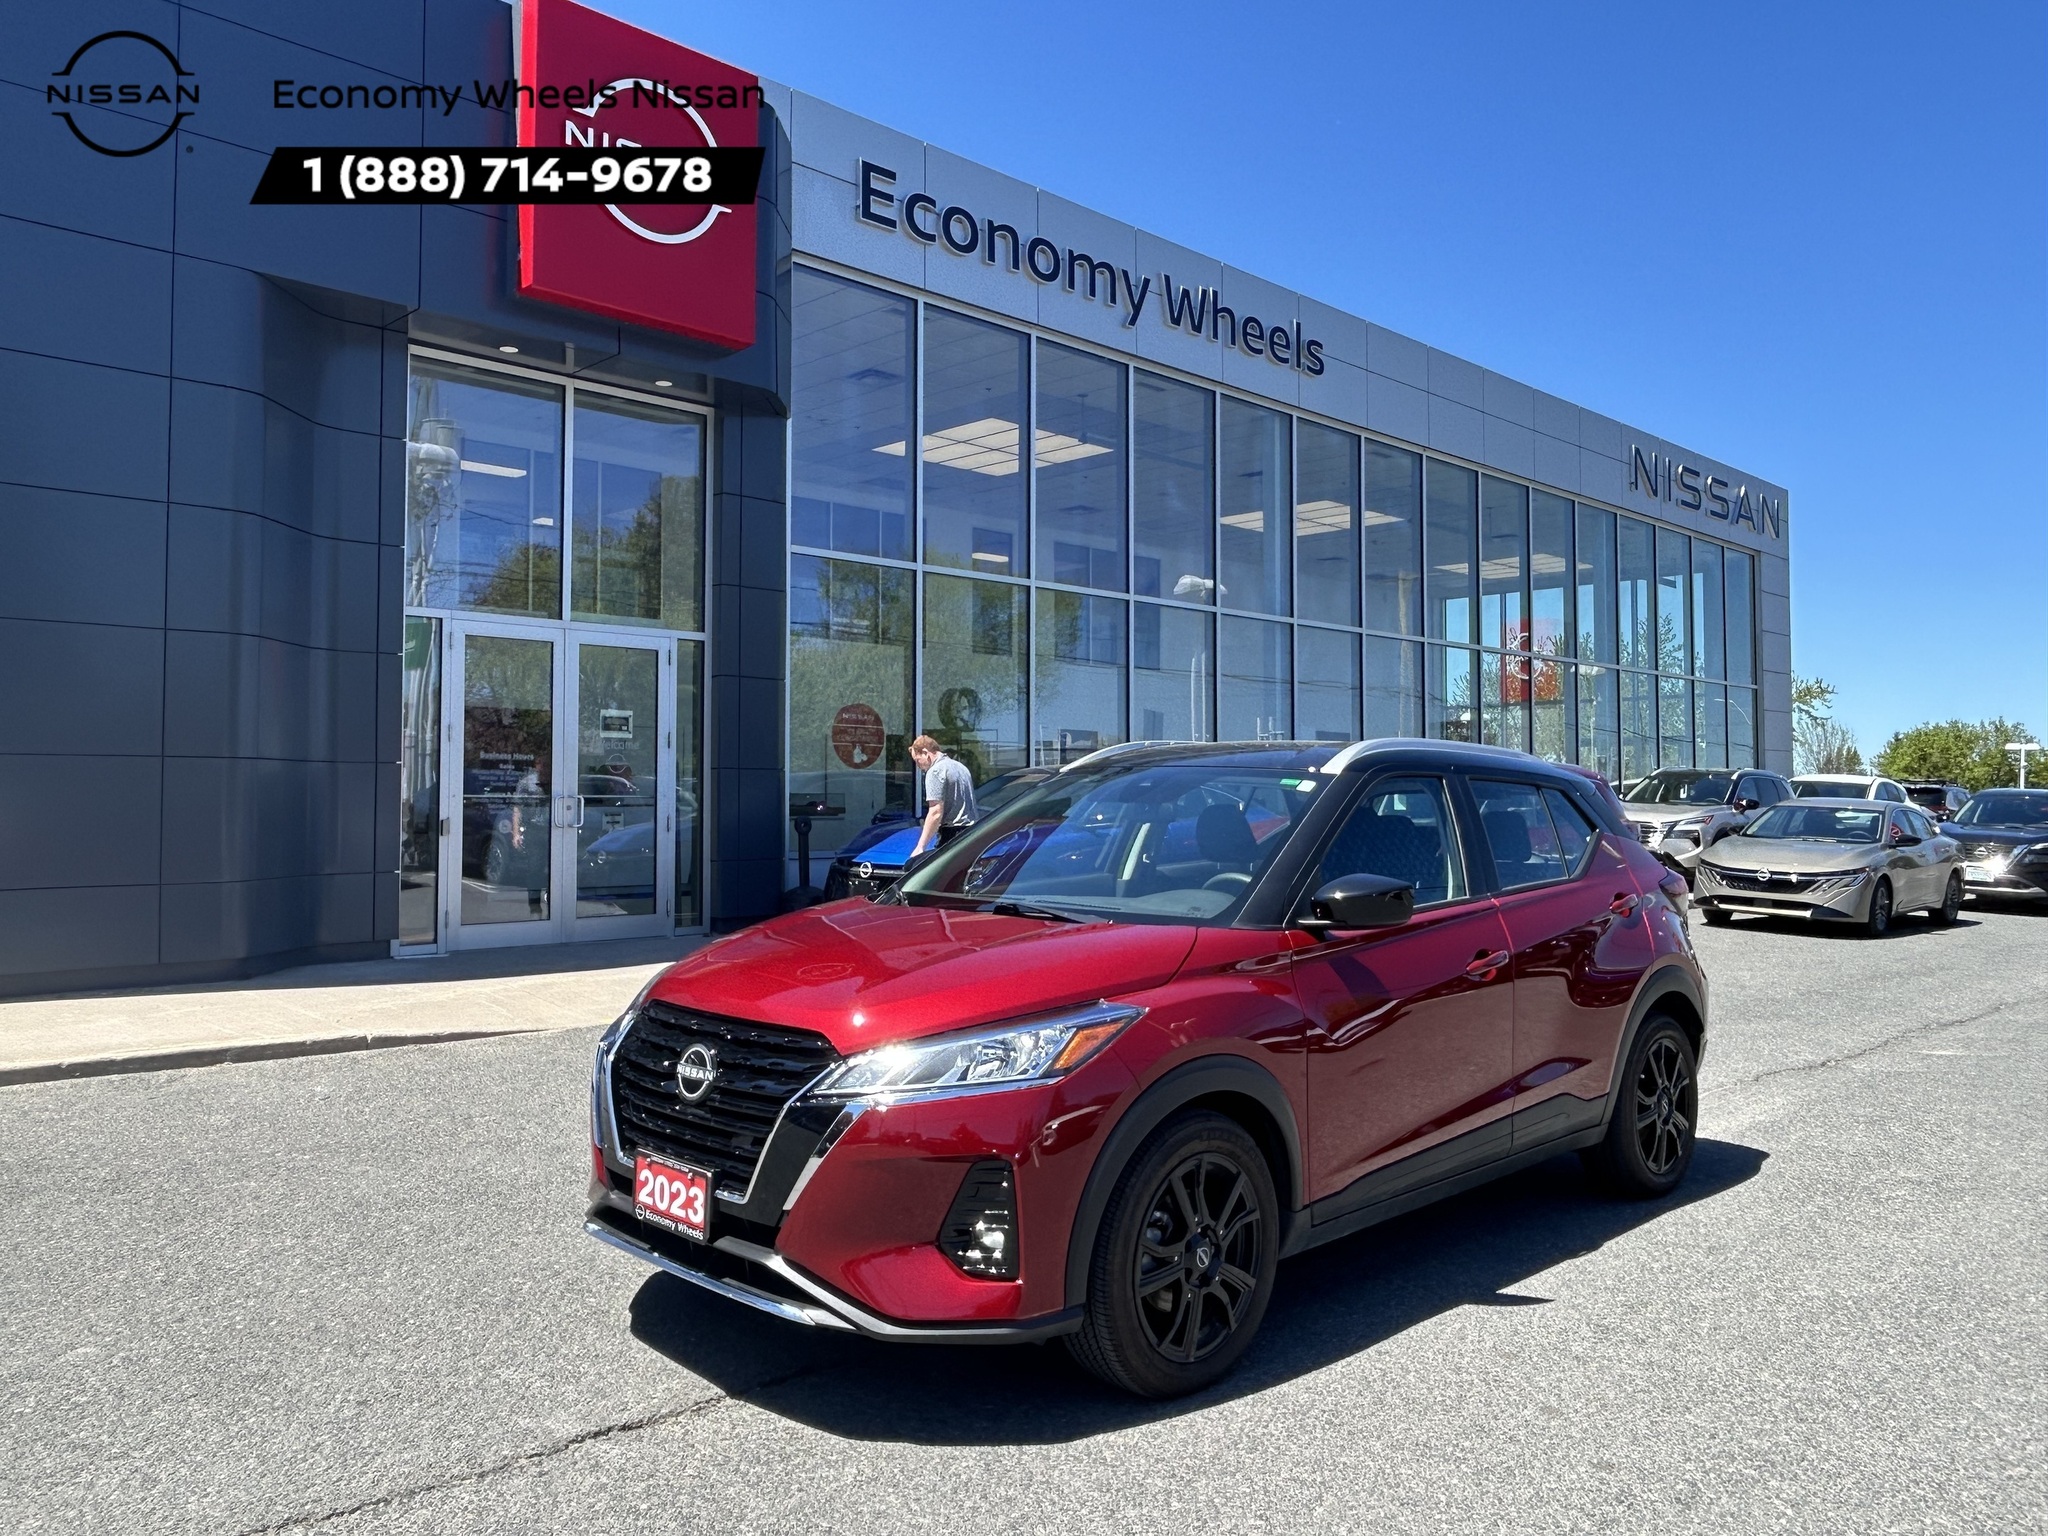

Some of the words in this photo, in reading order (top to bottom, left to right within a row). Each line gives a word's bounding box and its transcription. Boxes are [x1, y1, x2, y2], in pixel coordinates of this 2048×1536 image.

[856, 157, 1151, 328] Economy
[1161, 272, 1326, 377] Wheels
[1629, 444, 1780, 539] NISSAN
[676, 1063, 714, 1081] NISSAN
[638, 1168, 705, 1224] 2023
[645, 1209, 676, 1231] Economy
